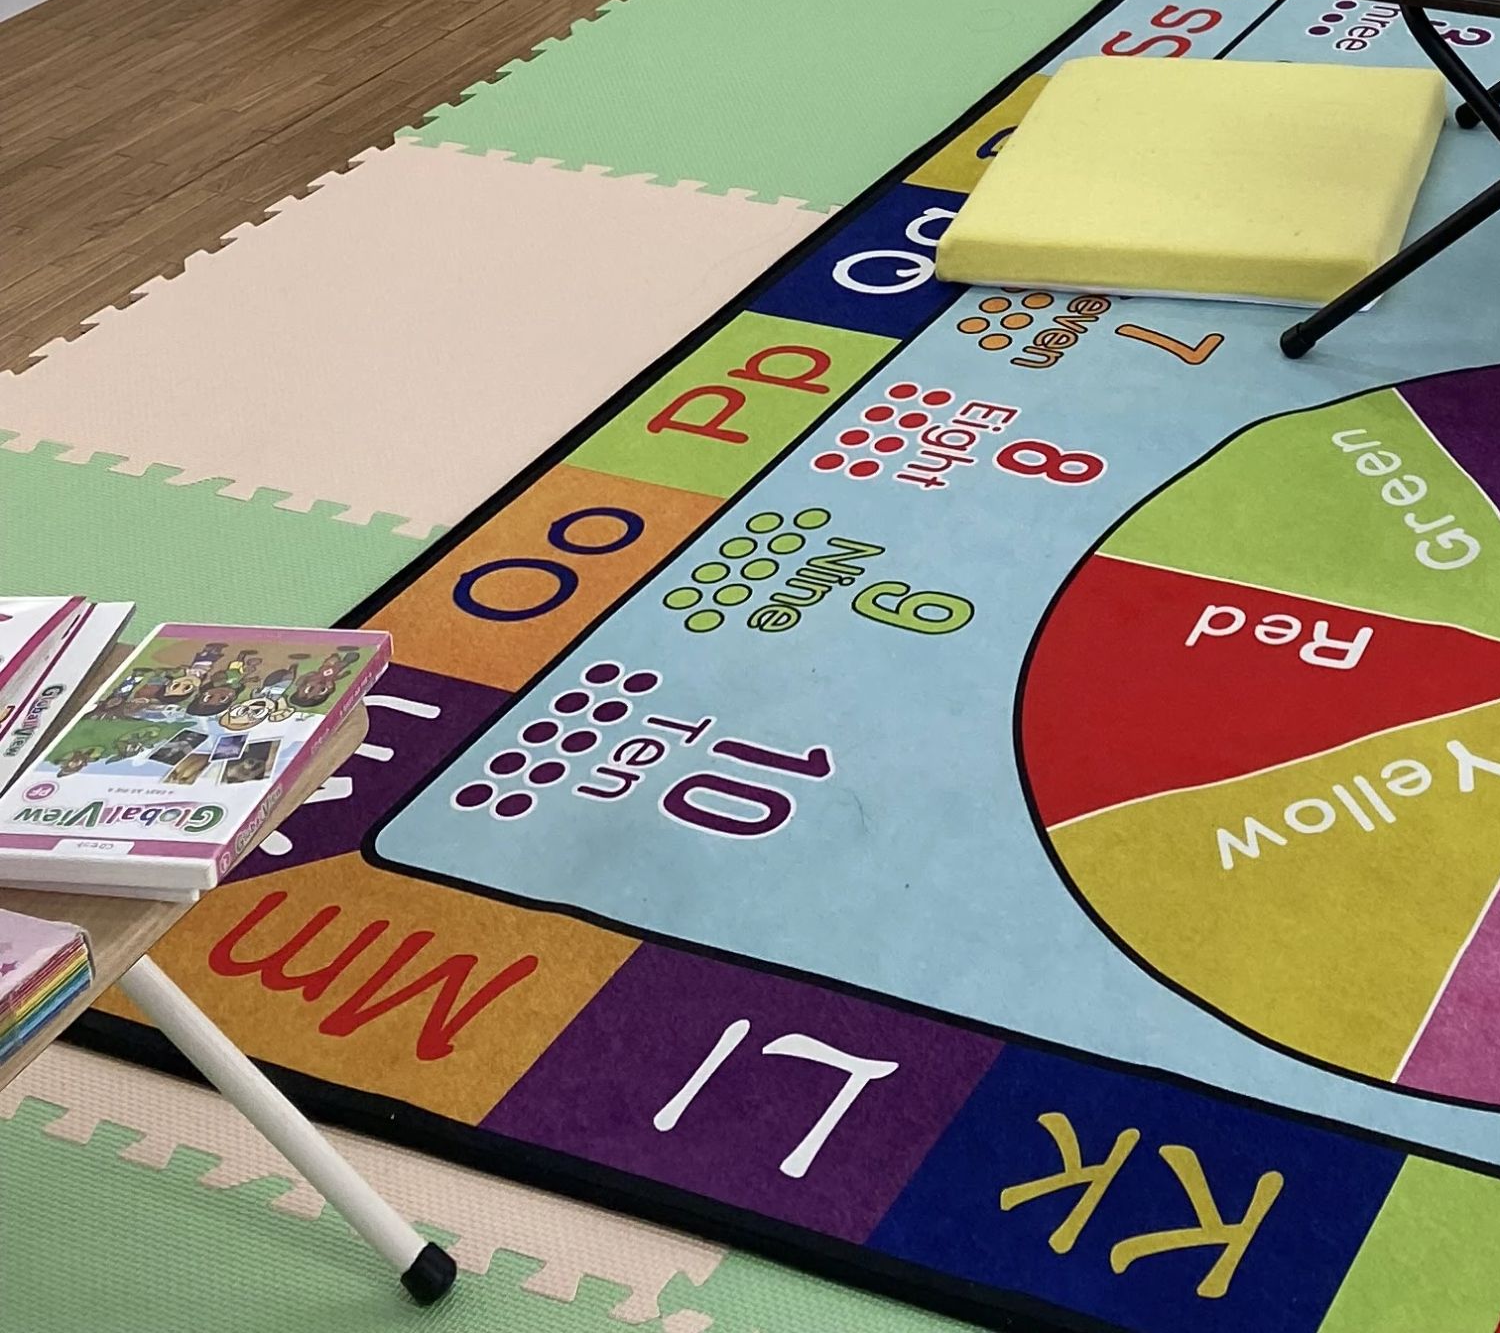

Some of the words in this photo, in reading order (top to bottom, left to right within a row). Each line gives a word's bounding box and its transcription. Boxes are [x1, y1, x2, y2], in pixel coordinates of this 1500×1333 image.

[1114, 323, 1226, 366] 7
[646, 345, 831, 444] Pp
[897, 401, 1018, 490] Eight
[998, 441, 1103, 485] 8
[1331, 427, 1480, 574] Green
[453, 507, 645, 621] Oo
[747, 536, 885, 632] Nine
[851, 581, 974, 634] 9
[1185, 601, 1375, 671] Red
[576, 716, 714, 800] Ten
[661, 739, 832, 837] 10
[208, 890, 540, 1062] Mm
[653, 1019, 899, 1179] Ll
[1000, 1111, 1285, 1298] Kk
